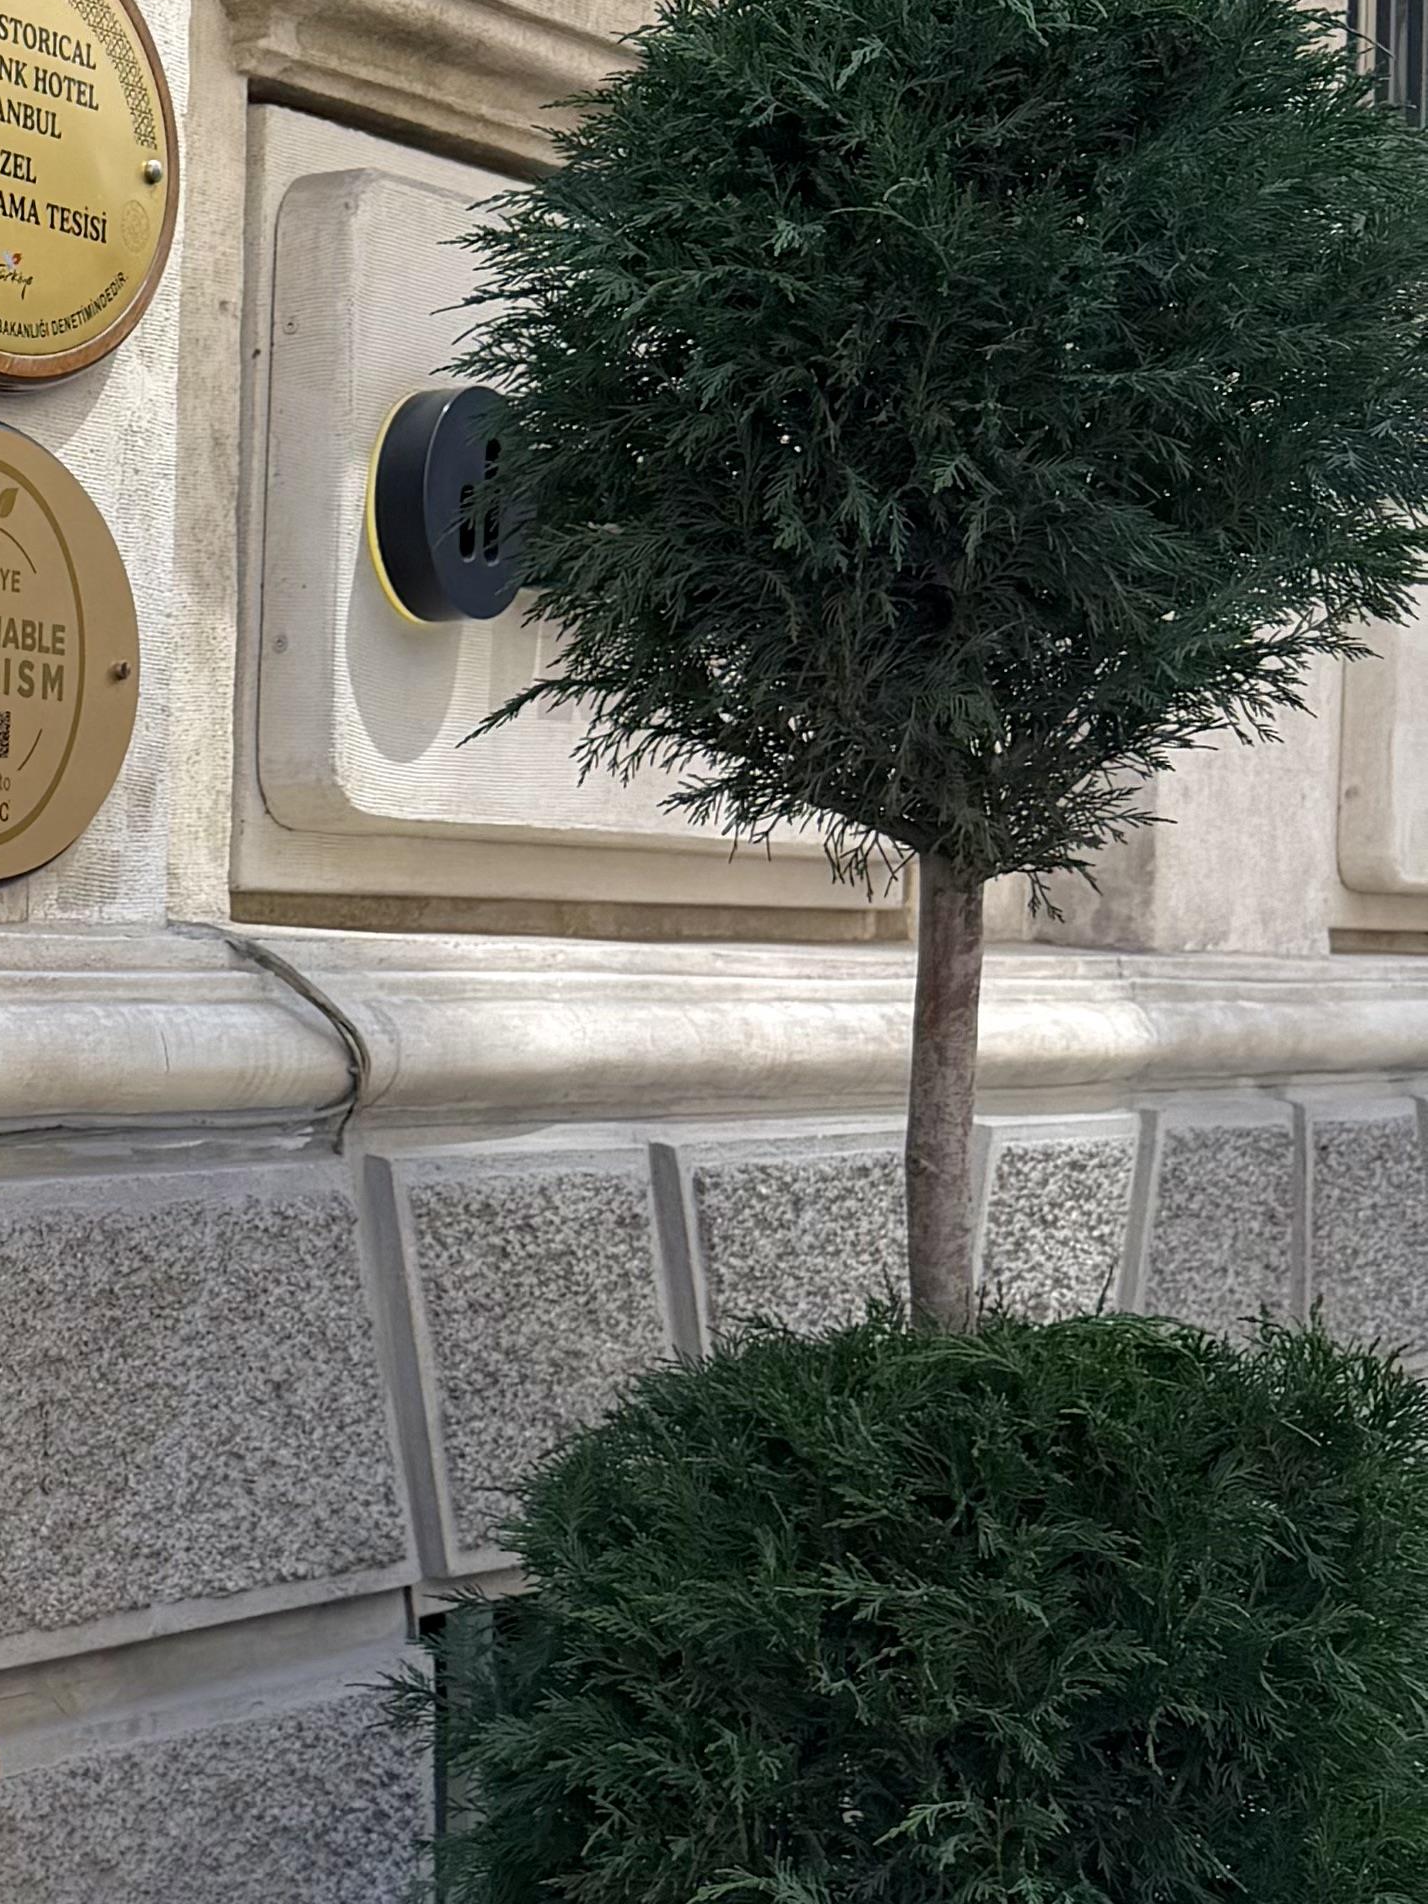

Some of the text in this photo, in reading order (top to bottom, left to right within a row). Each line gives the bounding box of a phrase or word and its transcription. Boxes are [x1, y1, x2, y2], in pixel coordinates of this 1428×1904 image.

[33, 66, 99, 111] HOTEL
[46, 205, 108, 244] TESİSİ
[0, 773, 12, 791] to
